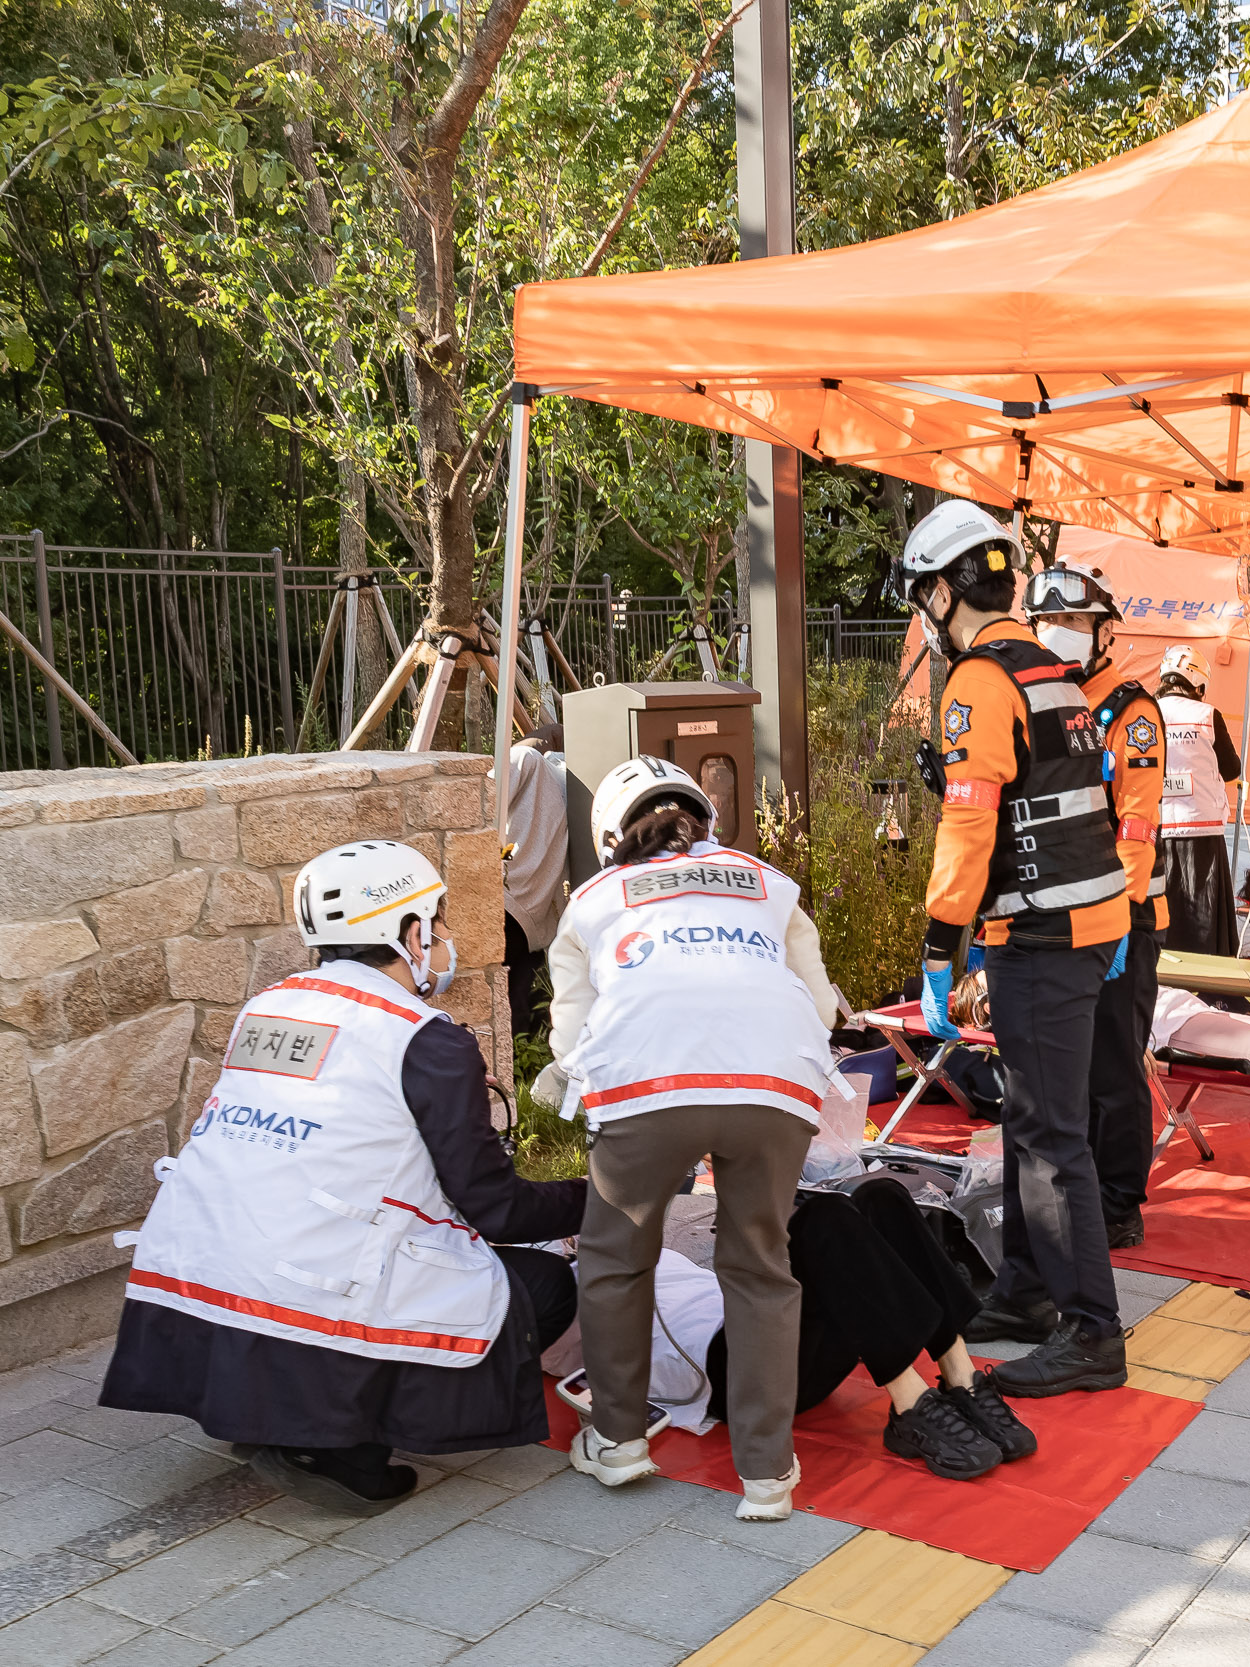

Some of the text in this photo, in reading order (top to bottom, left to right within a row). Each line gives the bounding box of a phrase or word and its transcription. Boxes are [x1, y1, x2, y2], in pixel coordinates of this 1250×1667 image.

[1166, 731, 1200, 740] DMAT
[630, 868, 757, 896] 응급처치반
[663, 926, 780, 953] KDMAT
[240, 1026, 316, 1063] 처치반
[216, 1104, 324, 1141] KDMAT
